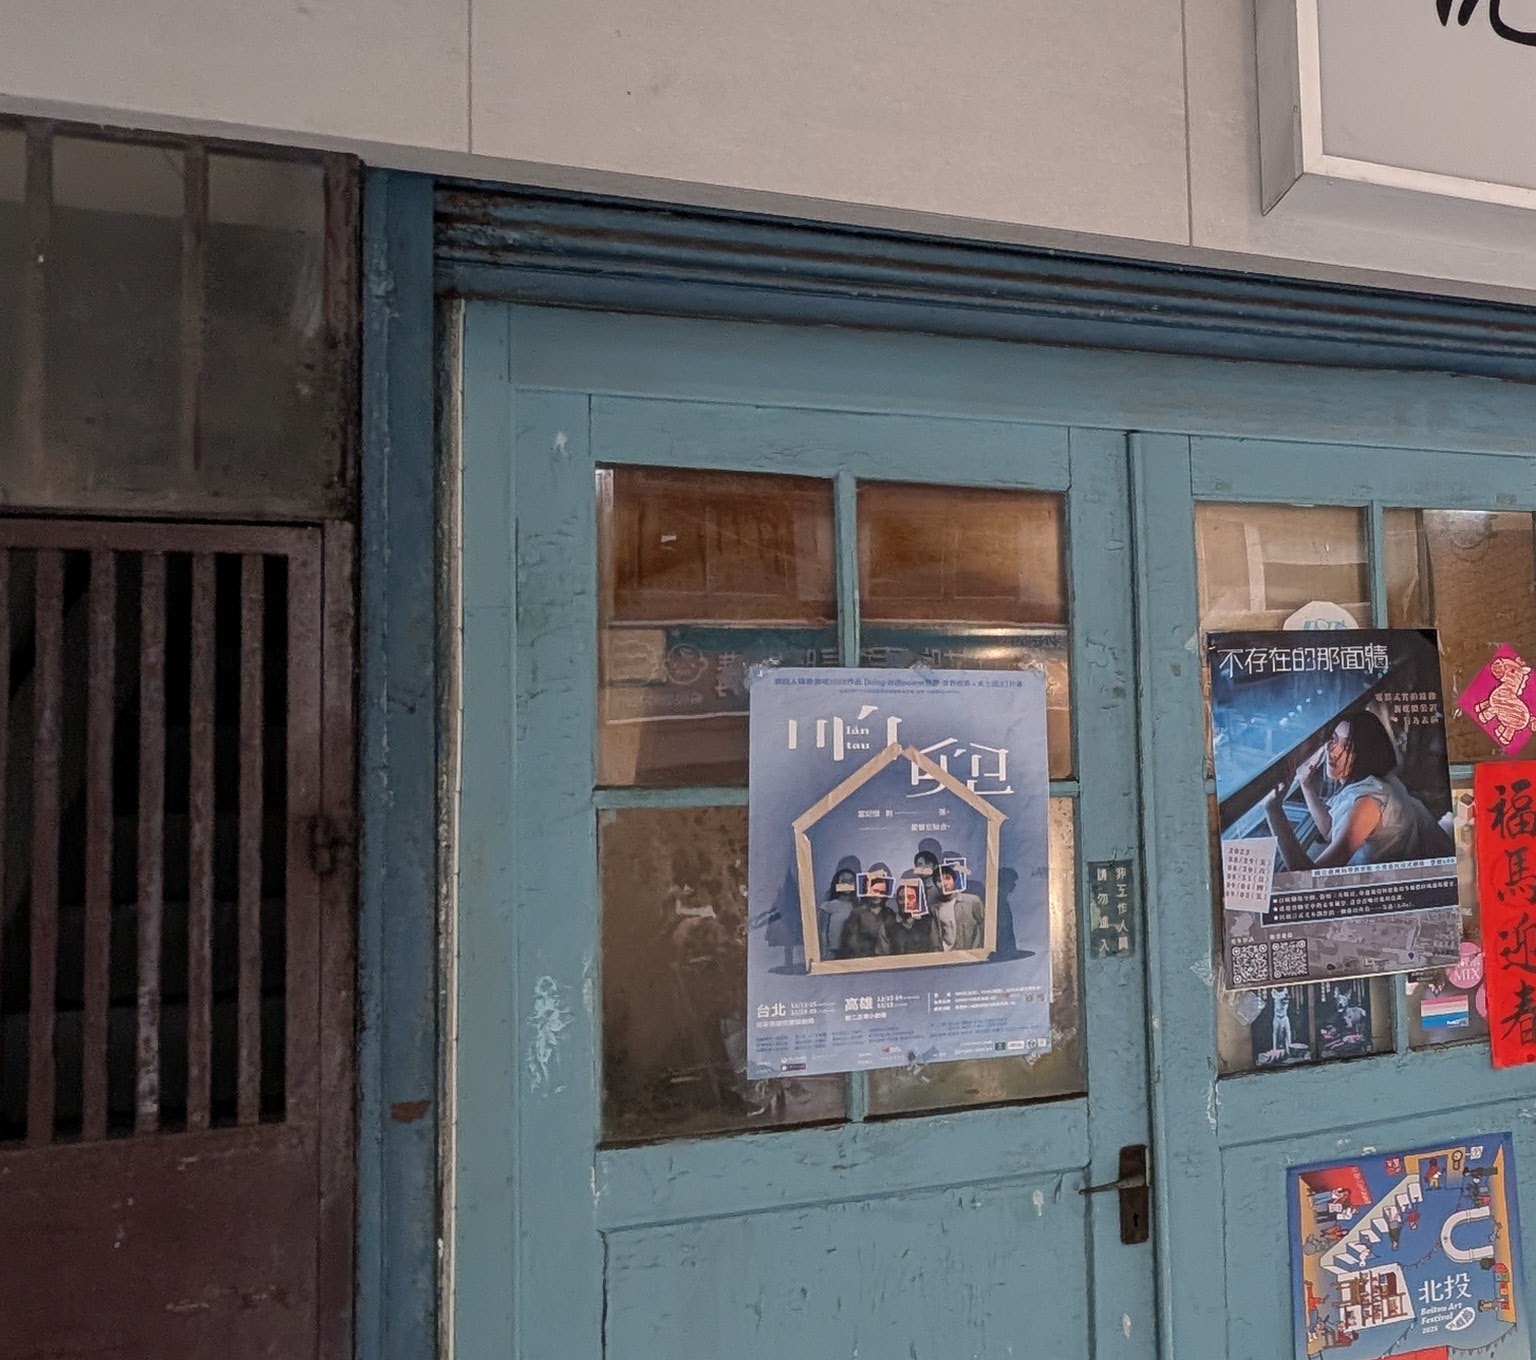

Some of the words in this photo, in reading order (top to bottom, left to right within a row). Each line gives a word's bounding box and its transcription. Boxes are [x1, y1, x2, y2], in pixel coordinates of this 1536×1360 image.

[1216, 642, 1390, 679] 不存在的那面牆
[1096, 867, 1111, 952] 請勿進入
[1115, 867, 1129, 951] 非工作人員
[757, 1002, 787, 1019] 台北
[1418, 1272, 1472, 1304] 北投
[1421, 1311, 1454, 1325] Festival
[1447, 1302, 1463, 1311] Art
